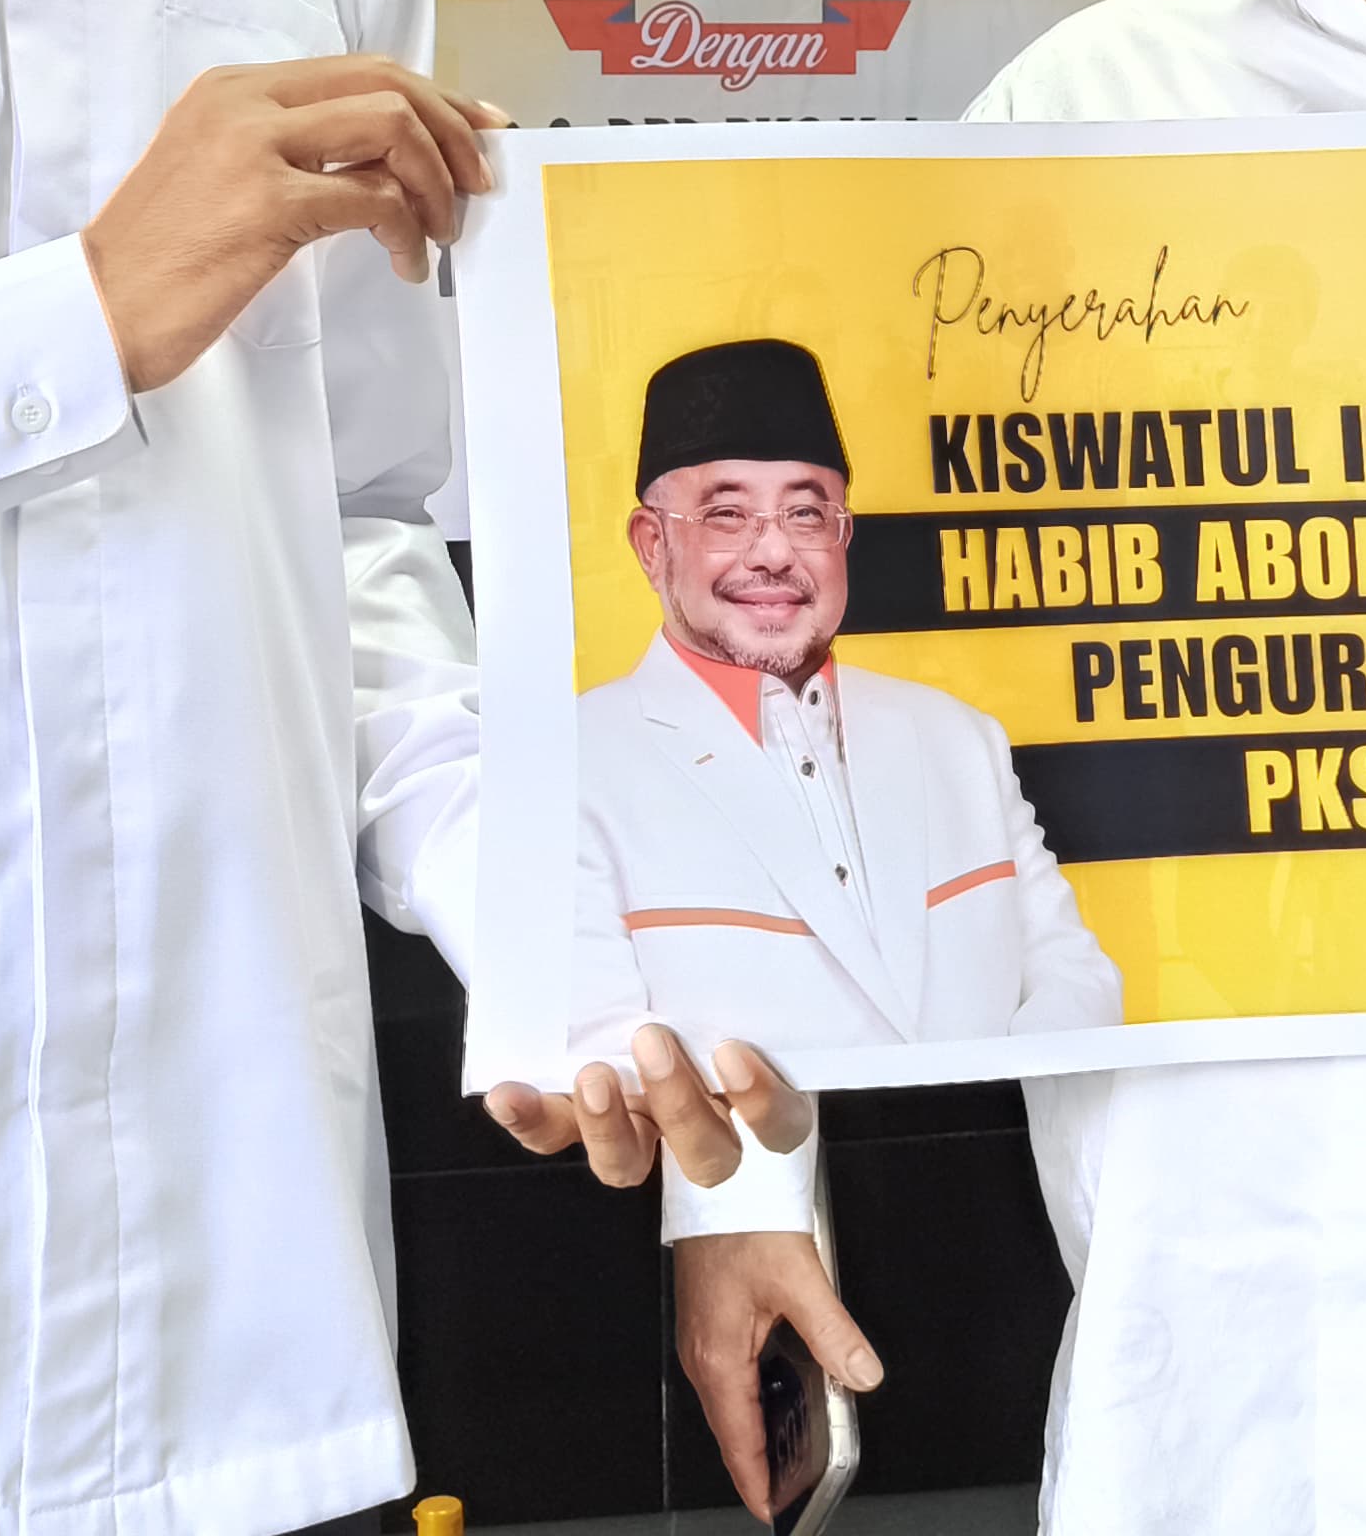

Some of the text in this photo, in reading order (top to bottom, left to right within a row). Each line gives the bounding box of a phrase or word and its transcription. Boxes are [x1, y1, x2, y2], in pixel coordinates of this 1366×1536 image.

[631, 1, 828, 92] Dengan
[912, 244, 1250, 403] Penyerahan
[929, 407, 1311, 495] KISWATUL
[939, 522, 1163, 613] HABIB
